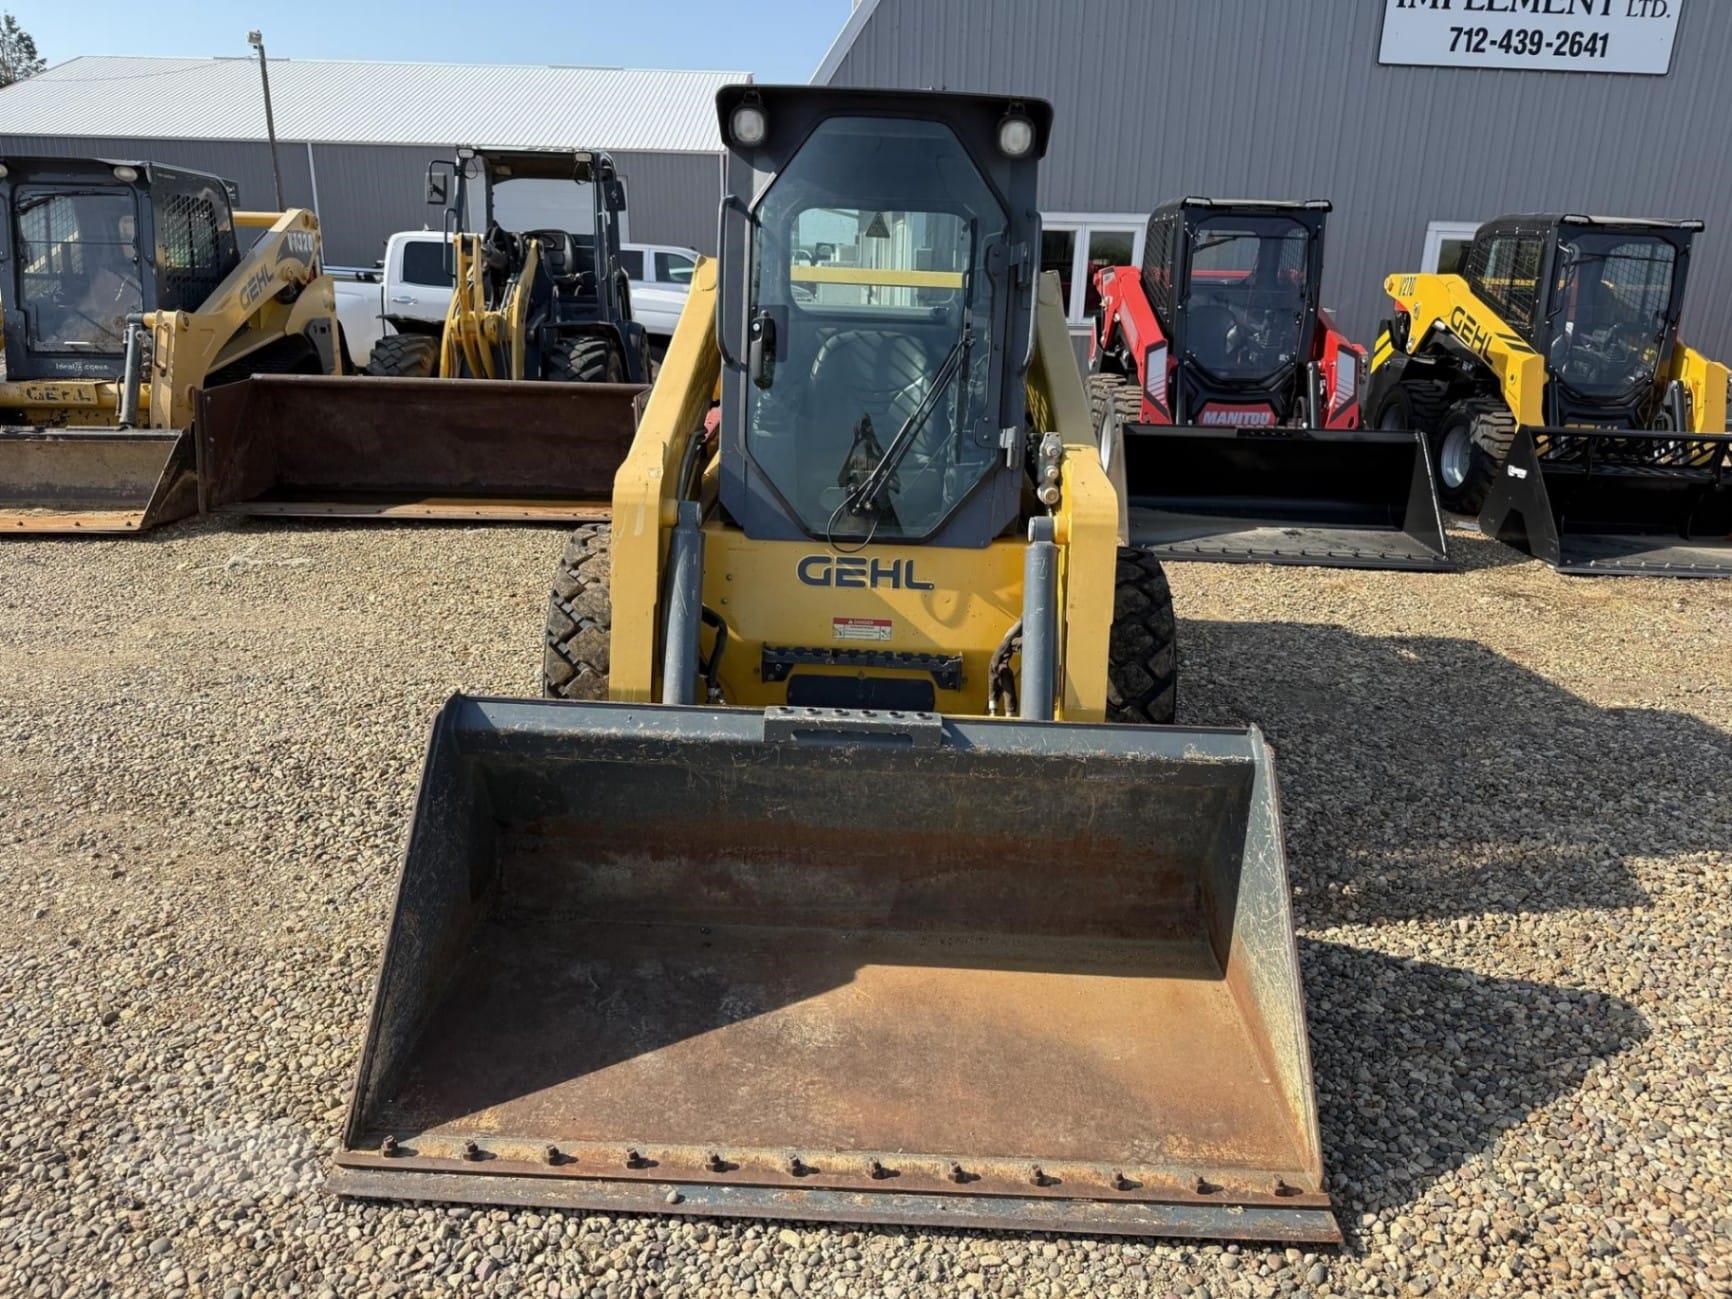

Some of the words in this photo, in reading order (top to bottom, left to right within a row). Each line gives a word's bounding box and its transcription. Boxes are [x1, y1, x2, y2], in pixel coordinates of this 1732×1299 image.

[1626, 0, 1671, 18] LTD.
[1449, 27, 1609, 58] 712-439-2641
[240, 264, 274, 310] GEHL
[1450, 306, 1493, 365] GEHL
[1203, 411, 1270, 425] MANITOU
[797, 555, 934, 590] GEHL
